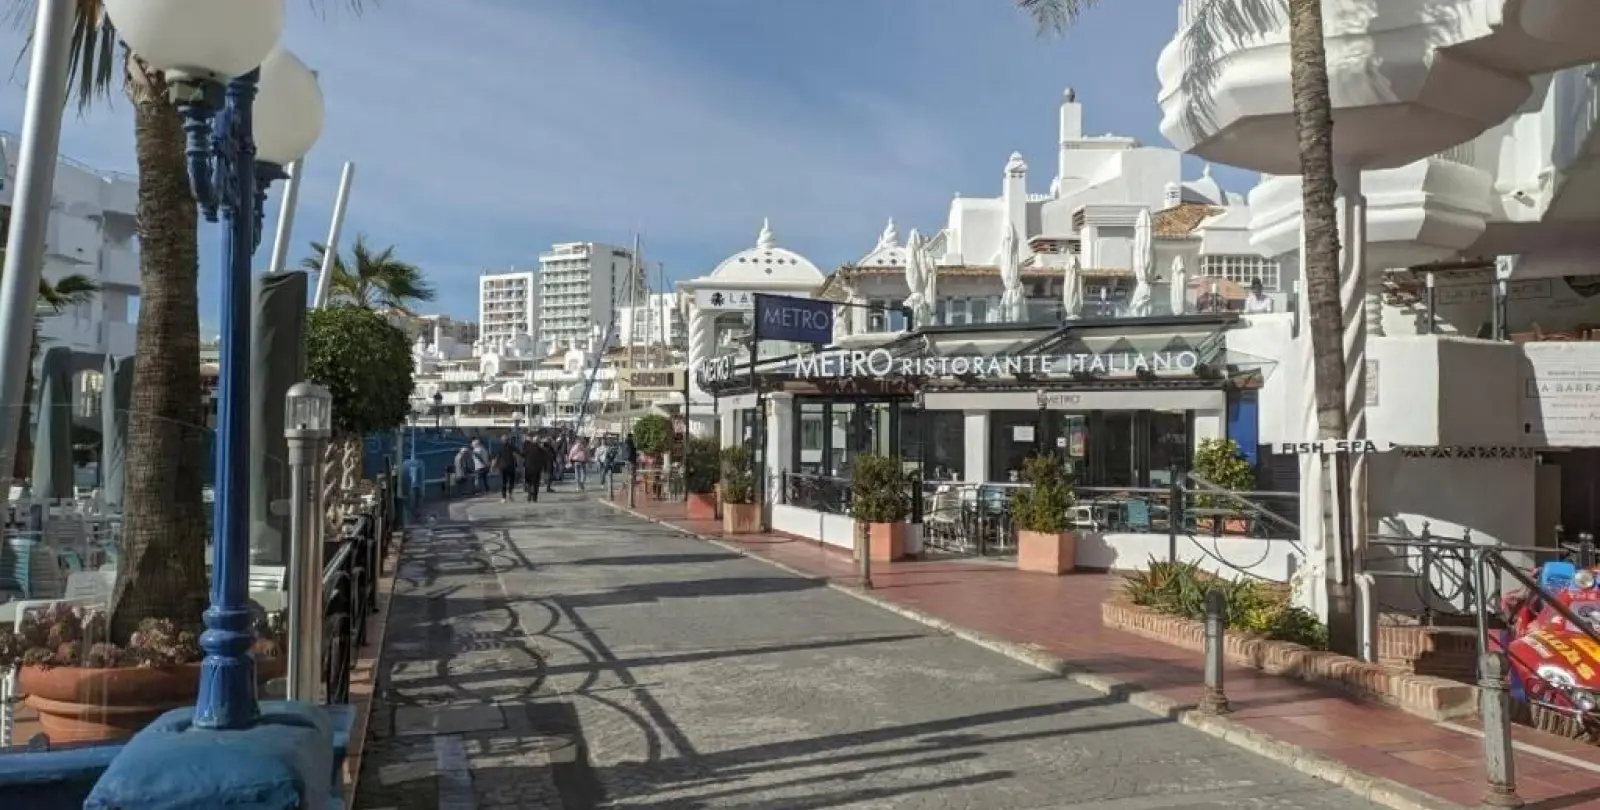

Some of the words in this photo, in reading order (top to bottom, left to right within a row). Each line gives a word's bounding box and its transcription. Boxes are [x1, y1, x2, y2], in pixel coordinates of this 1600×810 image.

[763, 306, 829, 331] METRO
[702, 355, 729, 383] METRO
[795, 348, 893, 379] METRO
[902, 355, 1053, 376] RISTORANTE
[1067, 350, 1197, 373] ITALIANO
[1282, 442, 1324, 454] FISH
[1336, 440, 1378, 453] SPA
